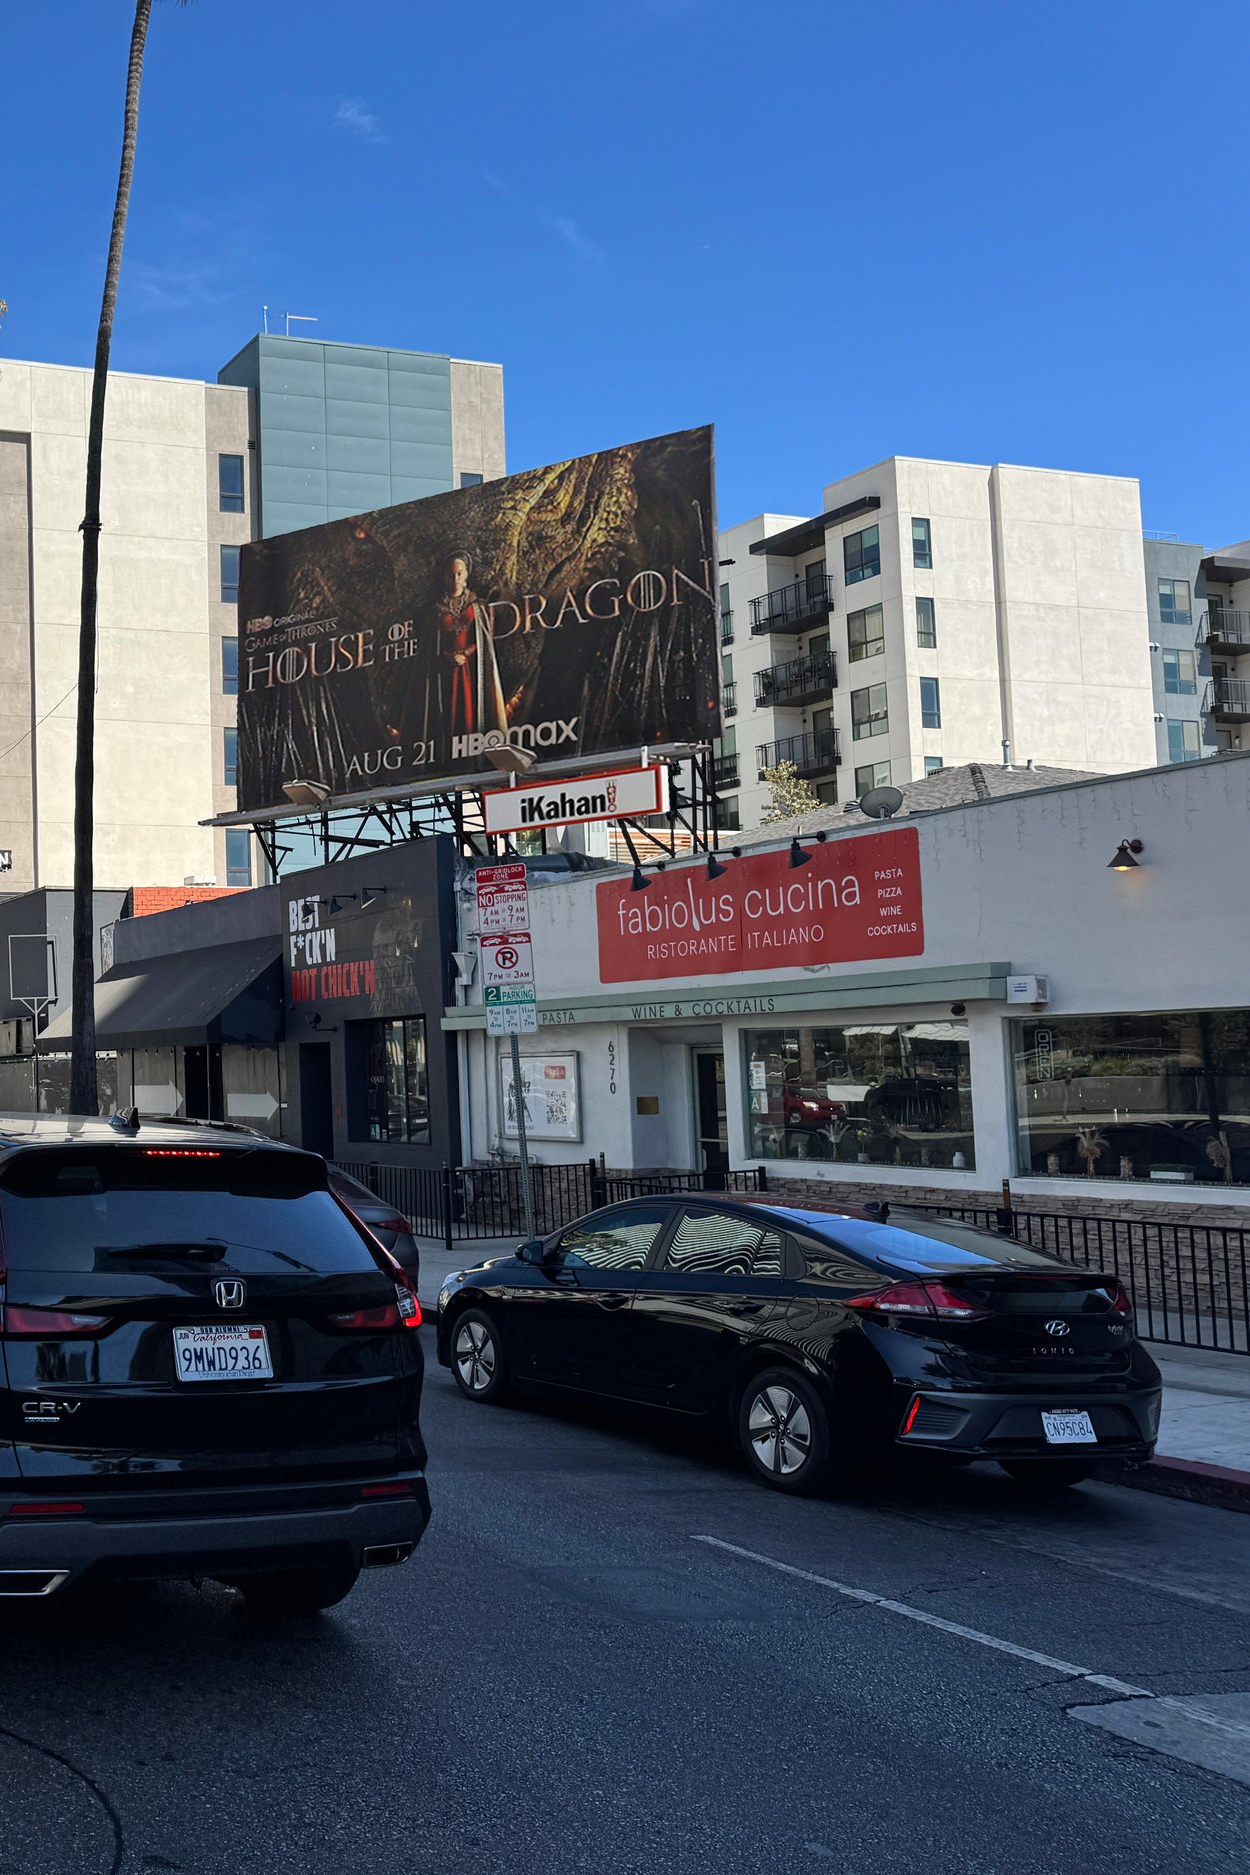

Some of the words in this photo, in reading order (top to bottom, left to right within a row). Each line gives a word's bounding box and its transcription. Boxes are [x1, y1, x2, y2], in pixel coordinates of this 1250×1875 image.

[479, 558, 716, 640] DRAGON
[246, 616, 273, 634] HBO
[273, 611, 317, 628] ORIGINAL
[387, 620, 414, 642] OF
[245, 629, 375, 693] HOUSE
[380, 638, 418, 662] THE
[345, 745, 403, 777] AUG
[412, 740, 435, 766] 21
[478, 866, 523, 877] ANTI-GRIDLOCK
[874, 867, 903, 881] PASTA
[478, 894, 493, 907] NO
[495, 892, 526, 905] STOPPING
[617, 877, 735, 936] fabiolus
[744, 872, 862, 919] cucina
[877, 887, 902, 899] PIZZA
[289, 895, 321, 932] BEST
[483, 907, 487, 917] 7
[507, 904, 514, 914] 9
[483, 917, 489, 926] 4
[491, 918, 500, 926] PM
[509, 914, 514, 923] 7
[879, 905, 902, 918] WINE
[867, 922, 917, 937] COCKTAILS
[647, 934, 738, 961] RISTORANTE
[747, 924, 825, 950] ITALIANO
[321, 959, 377, 1000] CHICK'N
[487, 987, 497, 1000] 2
[502, 989, 533, 1001] PARKING
[542, 1011, 576, 1025] PASTA
[631, 1005, 666, 1020] WINE
[674, 1006, 683, 1017] &
[692, 998, 775, 1017] COCKTAILS
[1037, 1032, 1051, 1079] OPEN
[607, 1040, 617, 1095] 6270
[751, 1096, 760, 1110] A
[178, 1332, 190, 1340] JUN
[193, 1332, 244, 1345] California
[182, 1345, 262, 1372] 9MWD936
[21, 1401, 81, 1414] CR-V
